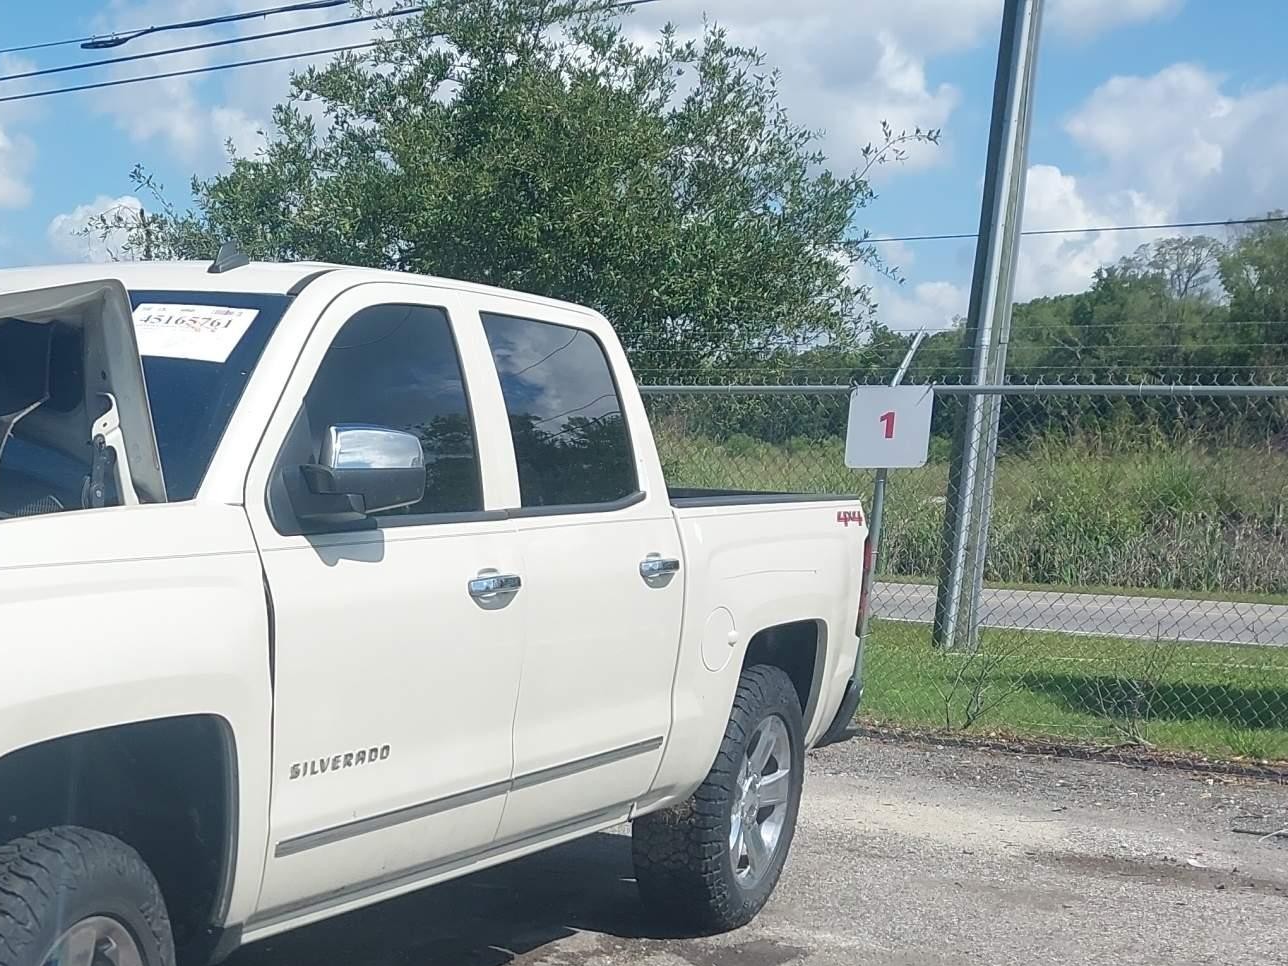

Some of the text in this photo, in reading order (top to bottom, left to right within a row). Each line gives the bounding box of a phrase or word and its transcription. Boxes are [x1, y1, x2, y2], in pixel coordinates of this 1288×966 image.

[139, 314, 233, 329] 45165761
[879, 411, 896, 439] 1
[289, 744, 391, 780] SILVERADO
